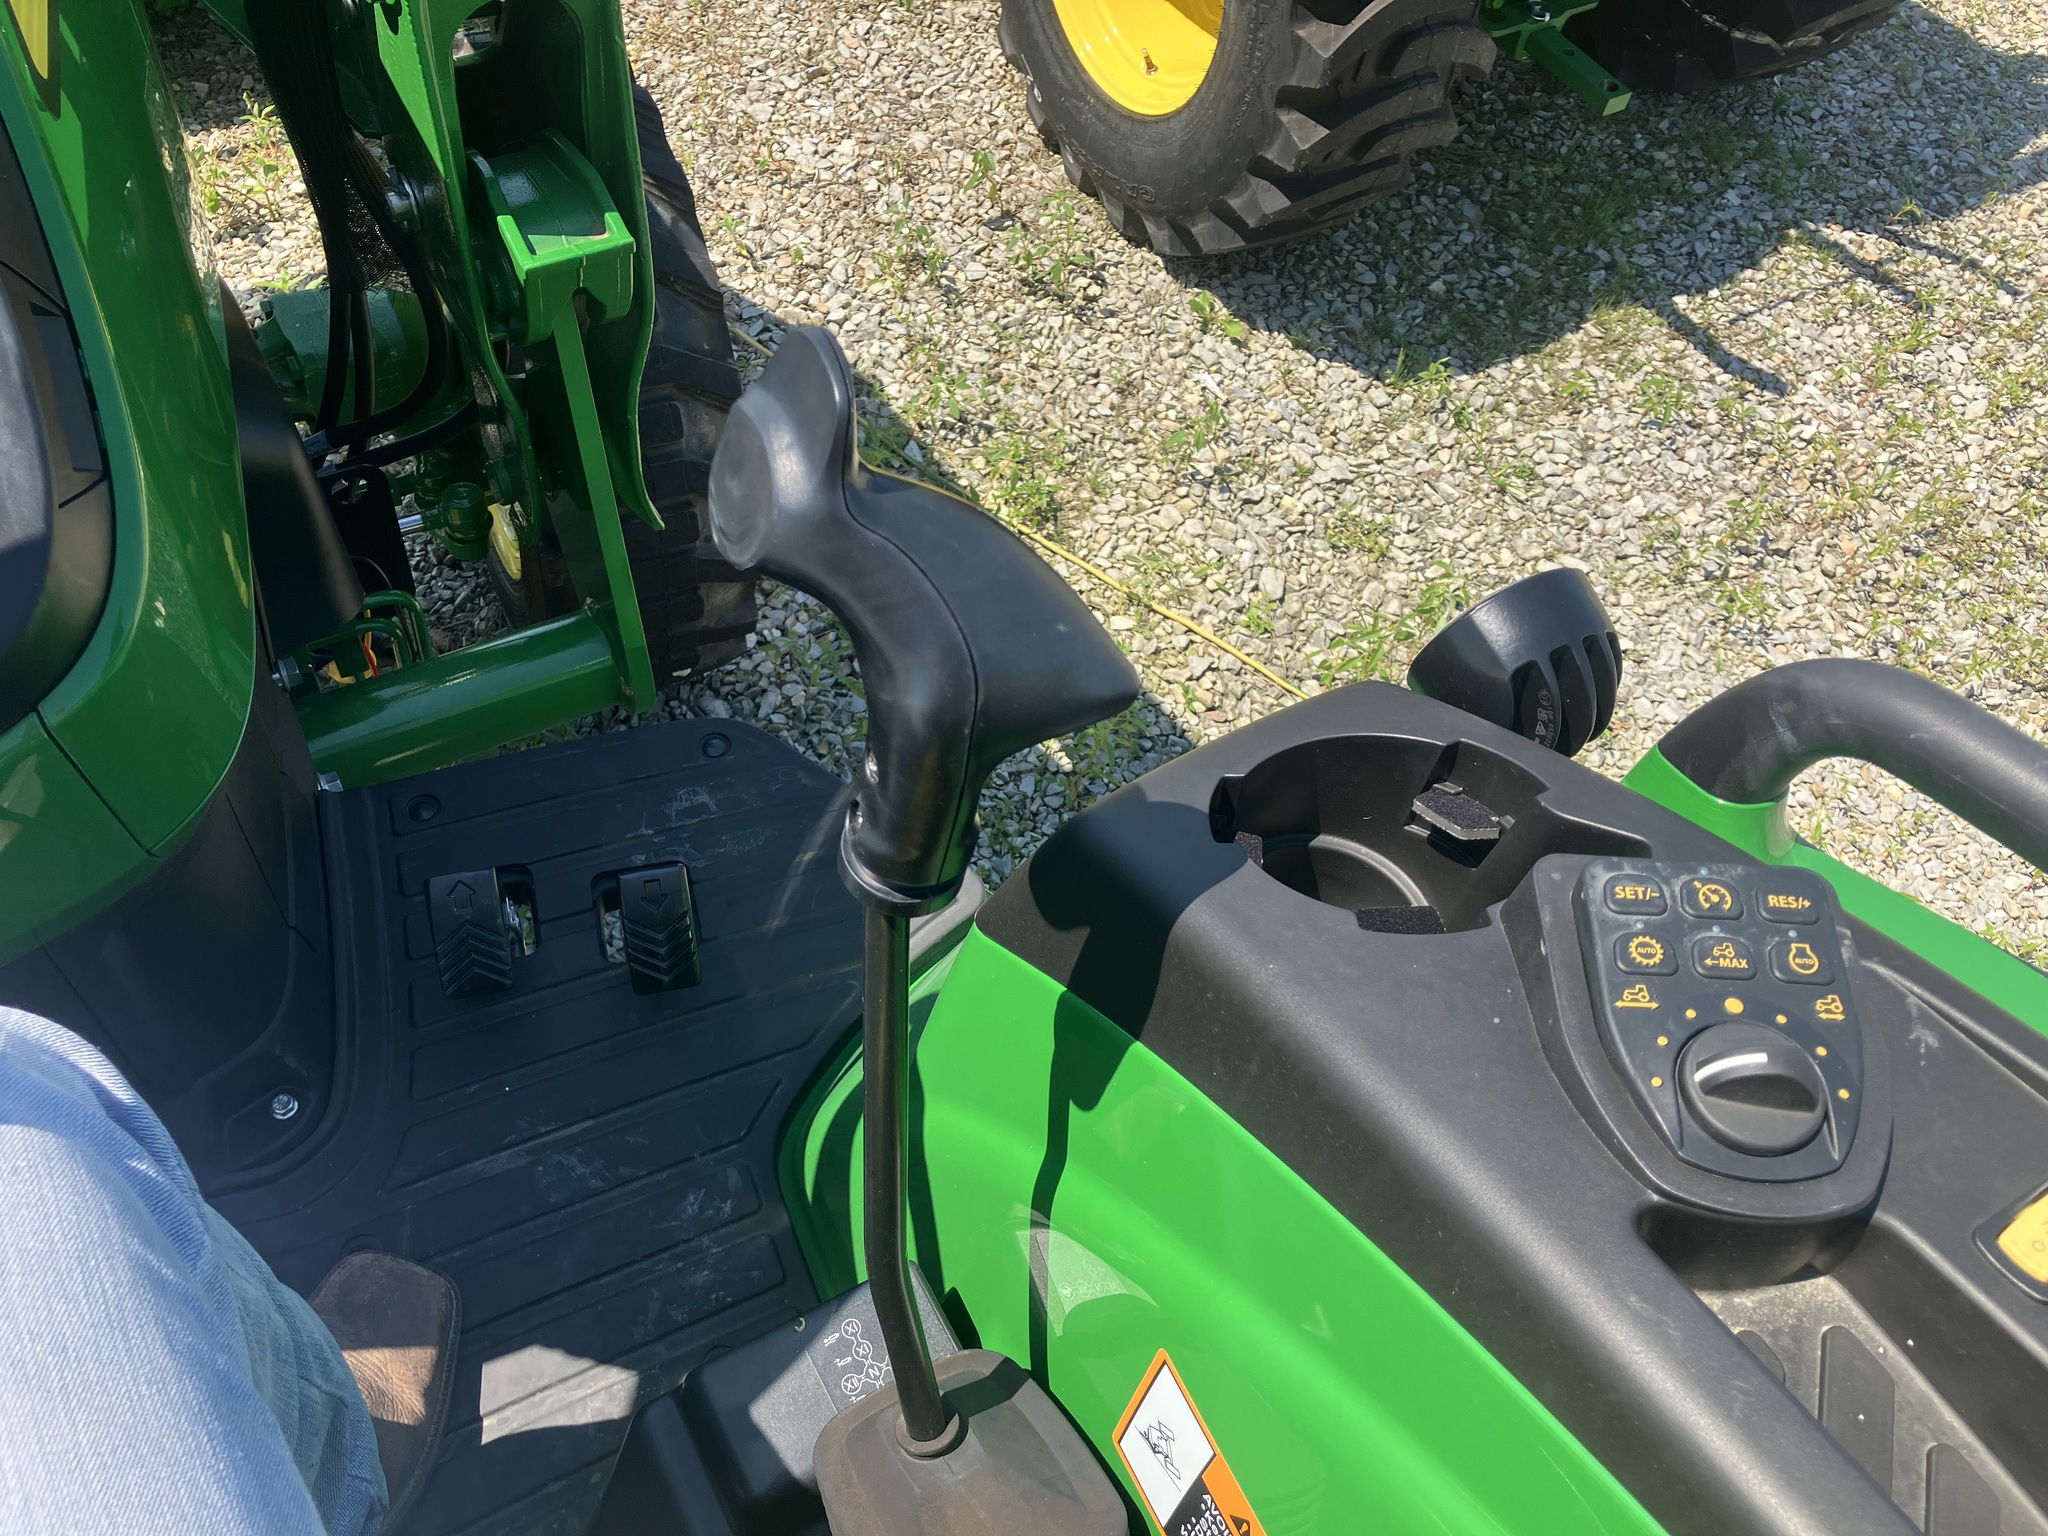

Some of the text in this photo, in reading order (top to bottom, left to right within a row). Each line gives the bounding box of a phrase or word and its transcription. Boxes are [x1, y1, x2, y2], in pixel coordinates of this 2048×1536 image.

[1767, 894, 1812, 909] RES/+
[1719, 957, 1749, 969] MAX
[1794, 957, 1814, 965] AUTO
[868, 1365, 881, 1379] N
